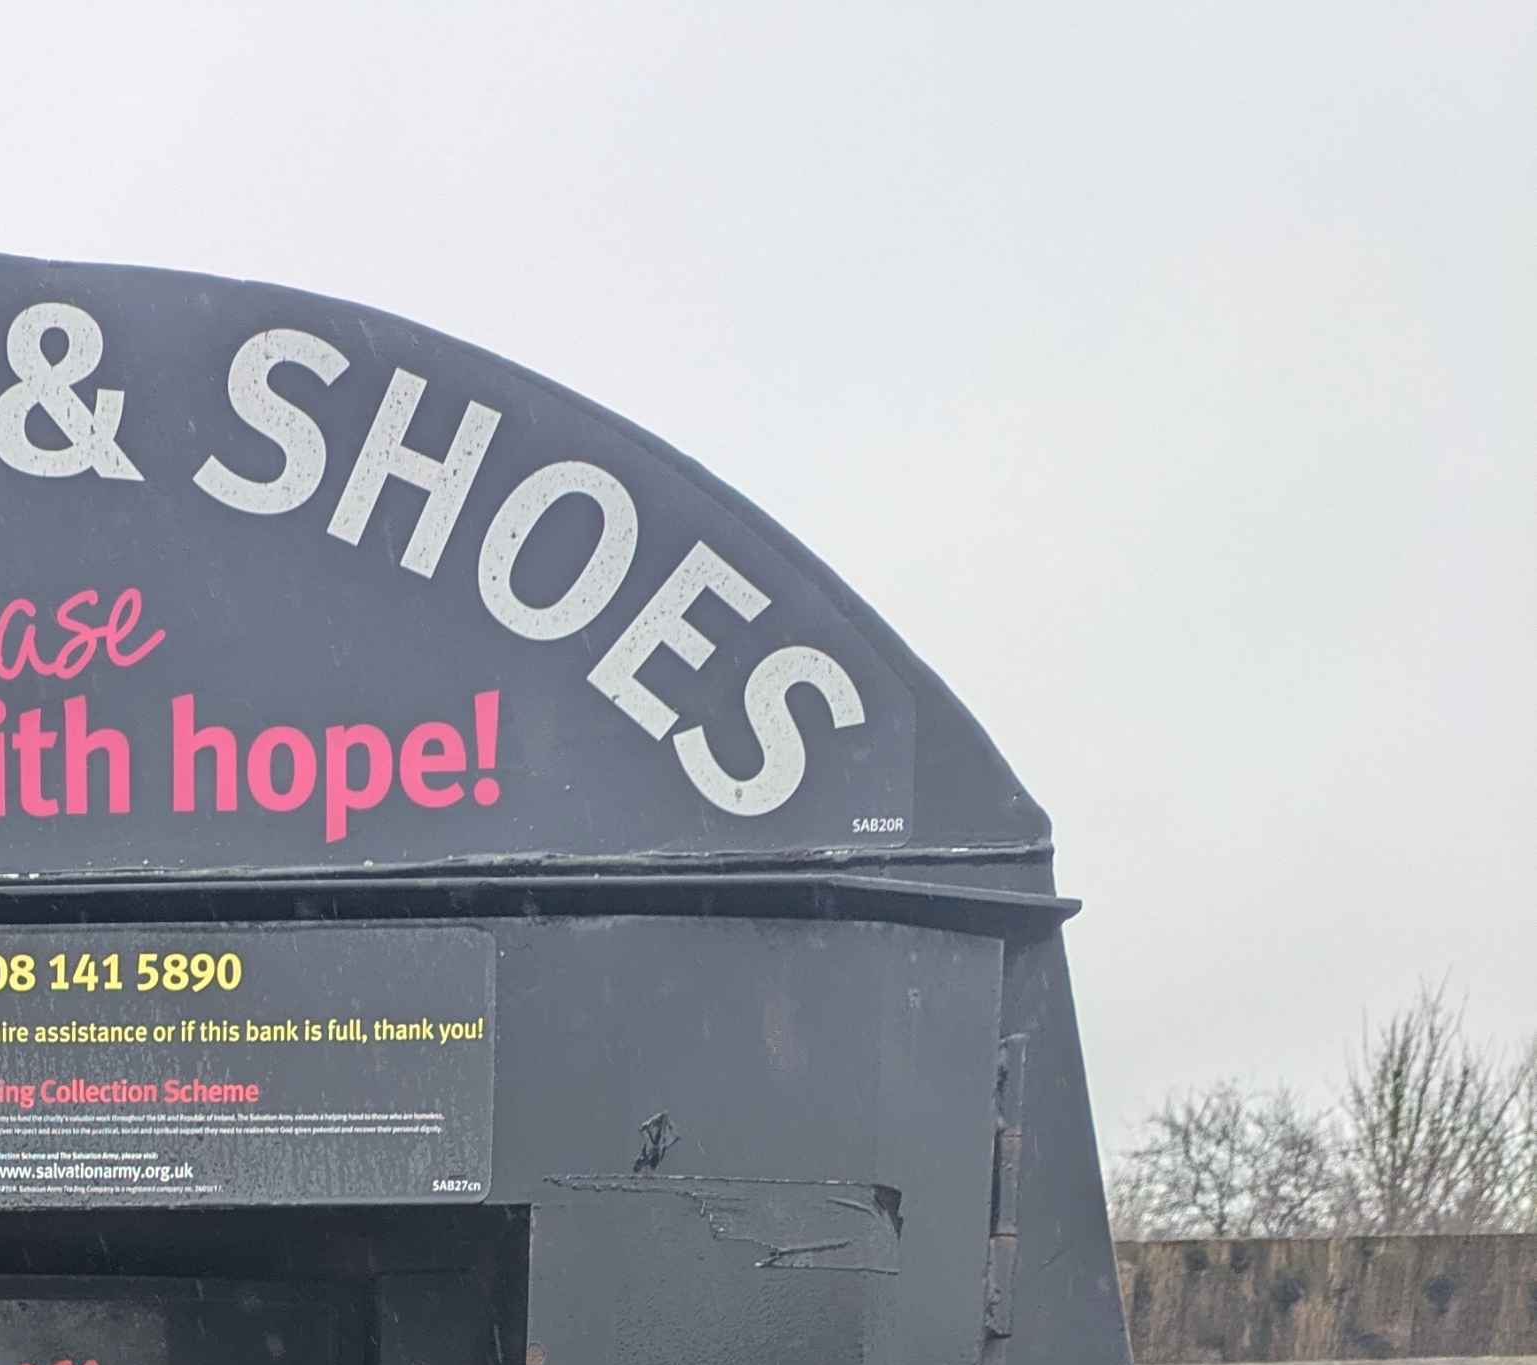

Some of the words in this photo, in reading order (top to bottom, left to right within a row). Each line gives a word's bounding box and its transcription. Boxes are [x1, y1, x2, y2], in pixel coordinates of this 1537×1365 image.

[191, 326, 867, 819] SHOES
[172, 691, 501, 843] hope!
[852, 817, 904, 833] SAB20R
[50, 953, 122, 993] 141
[136, 952, 243, 993] 5890
[34, 1023, 148, 1044] assistance
[152, 1024, 175, 1041] or
[178, 1019, 197, 1041] if
[201, 1021, 242, 1042] this
[245, 1021, 298, 1042] bank
[302, 1023, 322, 1041] is
[326, 1019, 369, 1041] full,
[373, 1019, 434, 1041] thank
[439, 1017, 485, 1043] you!
[40, 1078, 159, 1104] Collection
[162, 1078, 260, 1105] Scheme
[432, 1179, 482, 1192] SAB27cn
